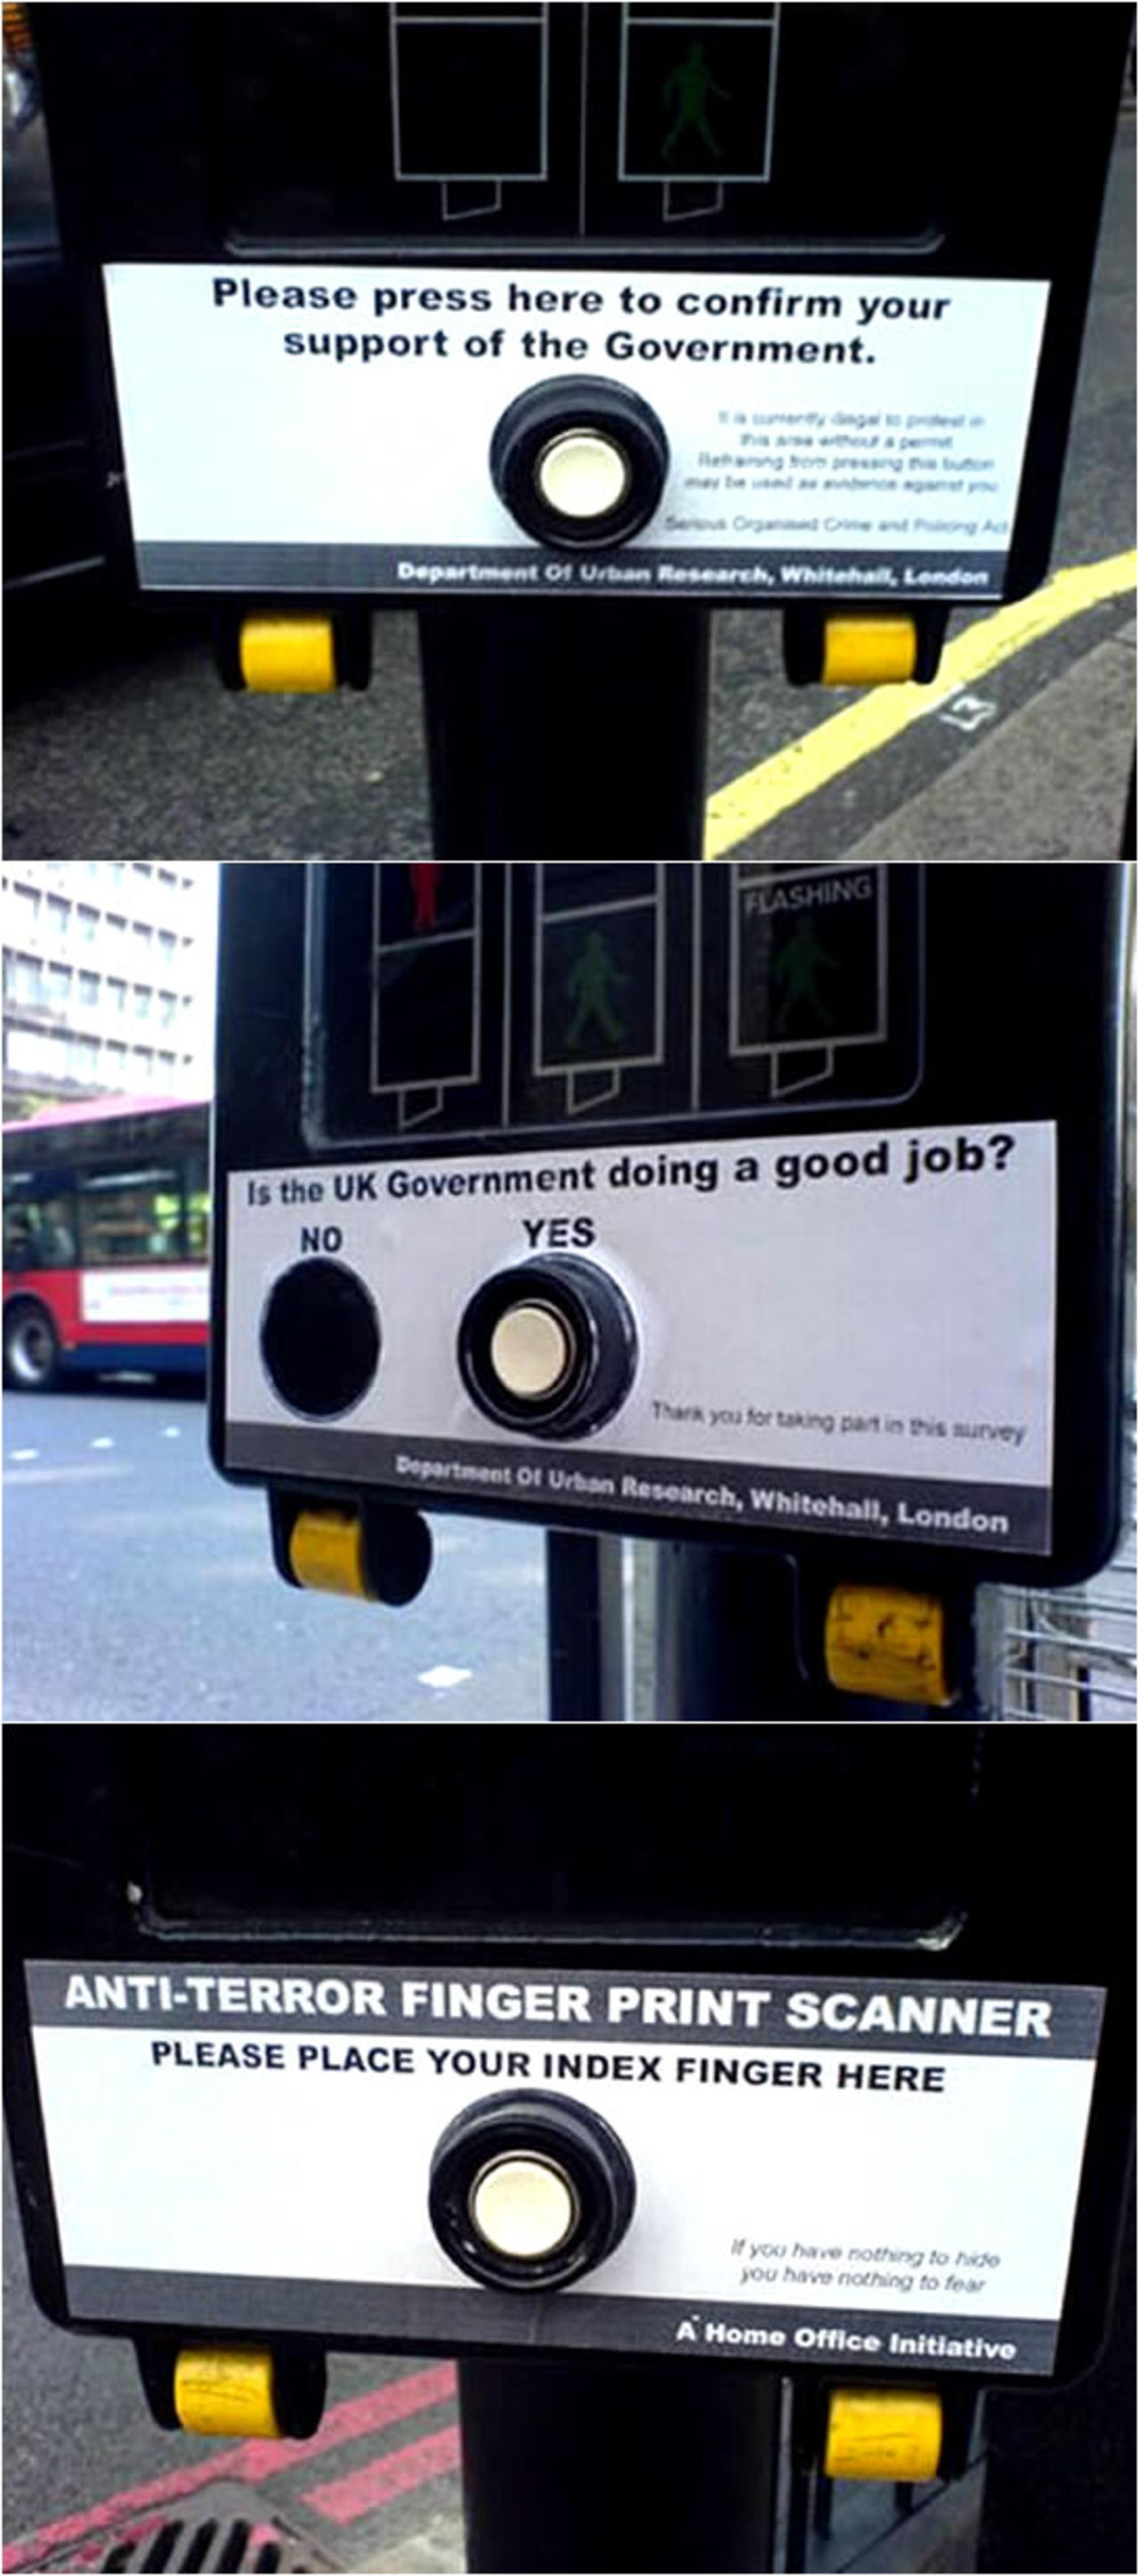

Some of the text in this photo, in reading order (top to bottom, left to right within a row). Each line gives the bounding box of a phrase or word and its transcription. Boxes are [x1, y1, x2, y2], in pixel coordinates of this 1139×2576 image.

[212, 277, 950, 326] Please press here to confirm your
[284, 329, 876, 365] support of the Government.
[397, 561, 990, 588] Department Of Urban Research, Whitehall, London
[745, 874, 873, 918] FLASHING
[247, 1133, 1016, 1207] Is the UK Government doing a good job?
[299, 1225, 343, 1252] NO
[521, 1216, 597, 1249] YES
[652, 1399, 1029, 1446] Thank you for taking part in this survey
[395, 1454, 1010, 1534] Department Of Urban Research, Whitehall, London
[64, 1974, 1054, 2039] ANTI-TERROR FINGER PRINT SCANNER
[151, 2040, 948, 2093] PLEASE PLACE YOUR INDEX FINGER HERE
[731, 2238, 1002, 2269] If you have nothing to hide
[739, 2266, 987, 2294] you have nothing to fear
[675, 2320, 1018, 2362] A Home Office Initiative
